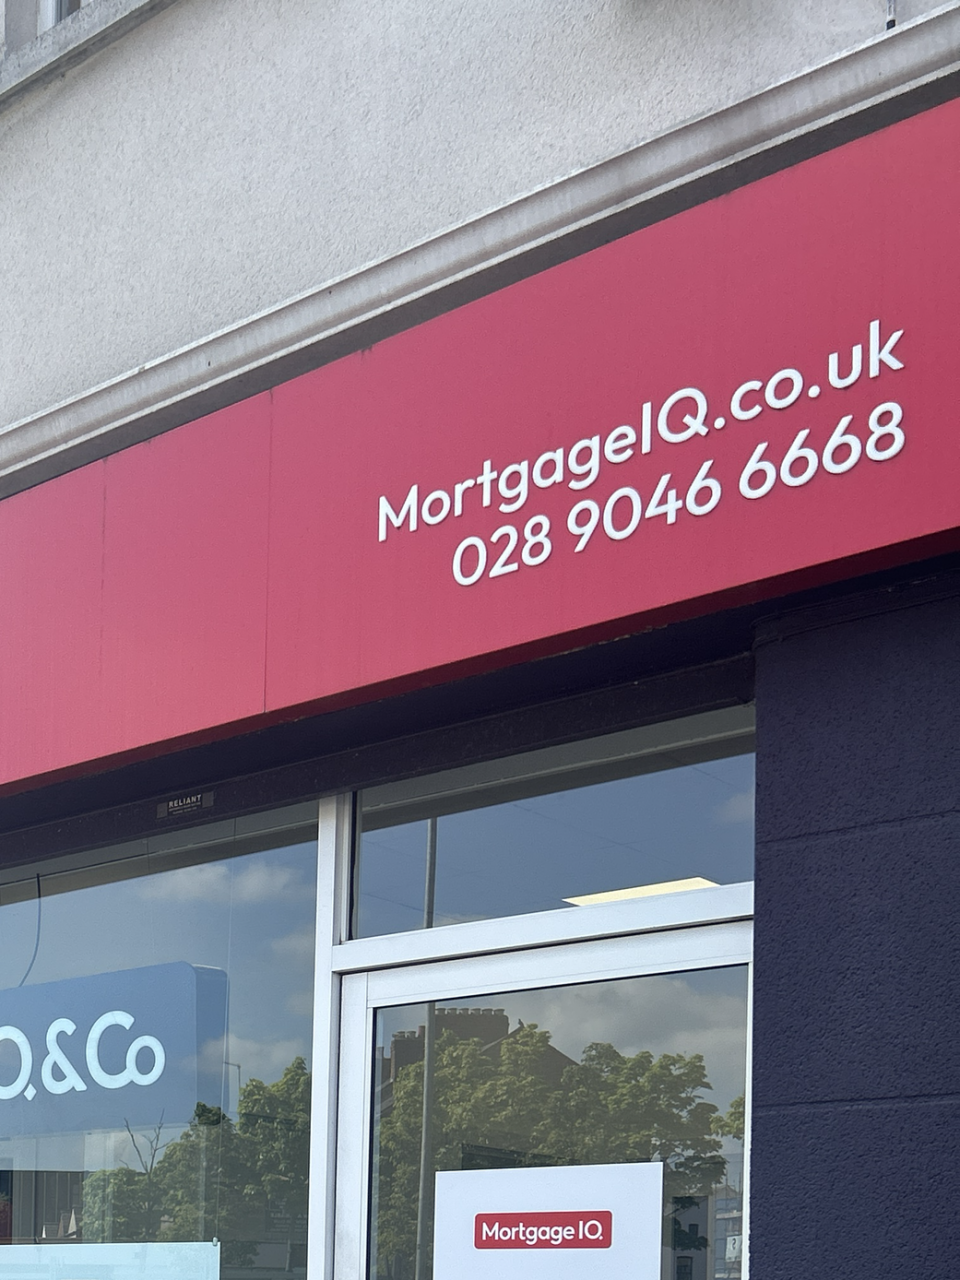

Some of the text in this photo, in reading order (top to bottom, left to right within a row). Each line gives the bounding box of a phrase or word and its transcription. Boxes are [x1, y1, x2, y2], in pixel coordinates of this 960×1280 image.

[377, 319, 905, 542] MortgageIQ.co.uk
[451, 402, 906, 586] 028 9046 6668
[168, 794, 202, 808] RELIANT
[482, 1222, 575, 1245] Mortgage
